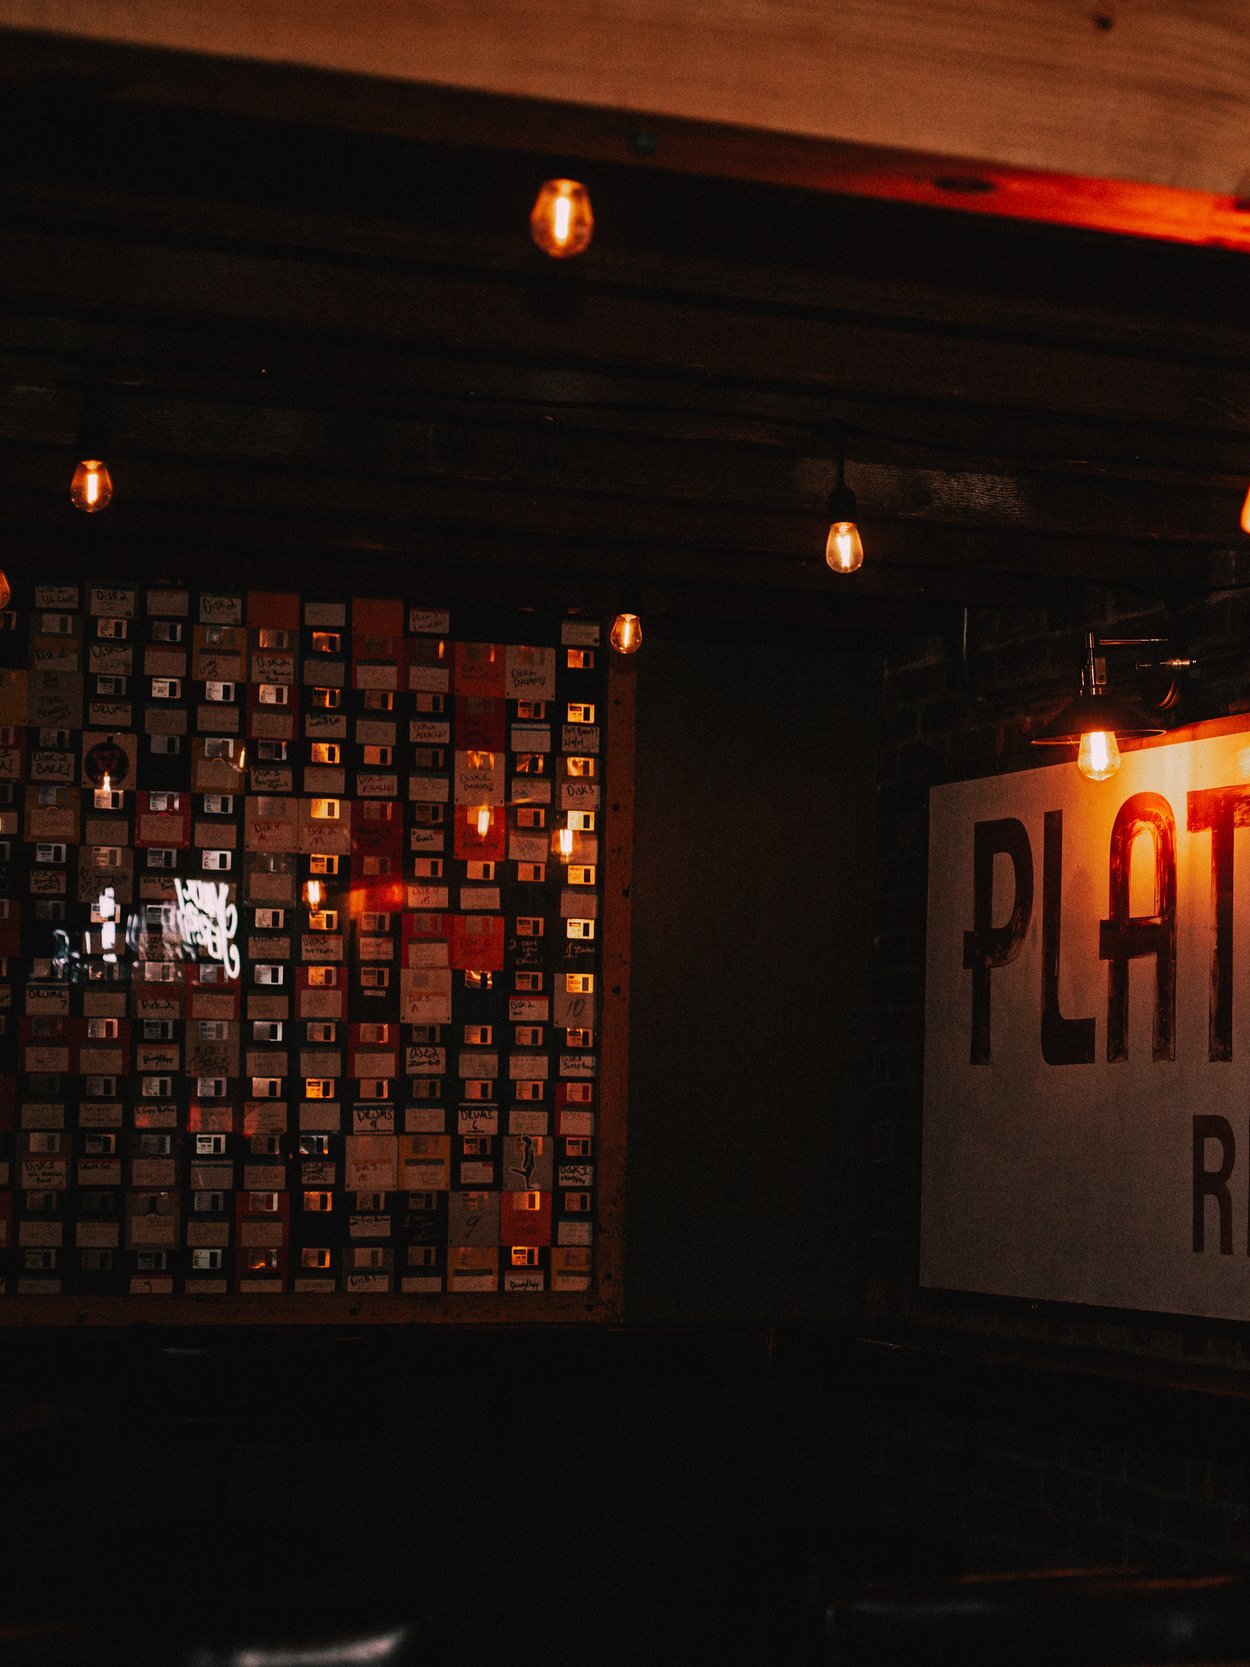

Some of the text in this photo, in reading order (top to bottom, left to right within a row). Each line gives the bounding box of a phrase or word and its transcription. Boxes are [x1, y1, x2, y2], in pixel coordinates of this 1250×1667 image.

[202, 598, 237, 614] Disk 2
[28, 989, 64, 1000] DRUMS
[565, 998, 585, 1018] 10
[356, 1108, 393, 1123] DRUMS
[459, 1109, 493, 1121] DRUMS
